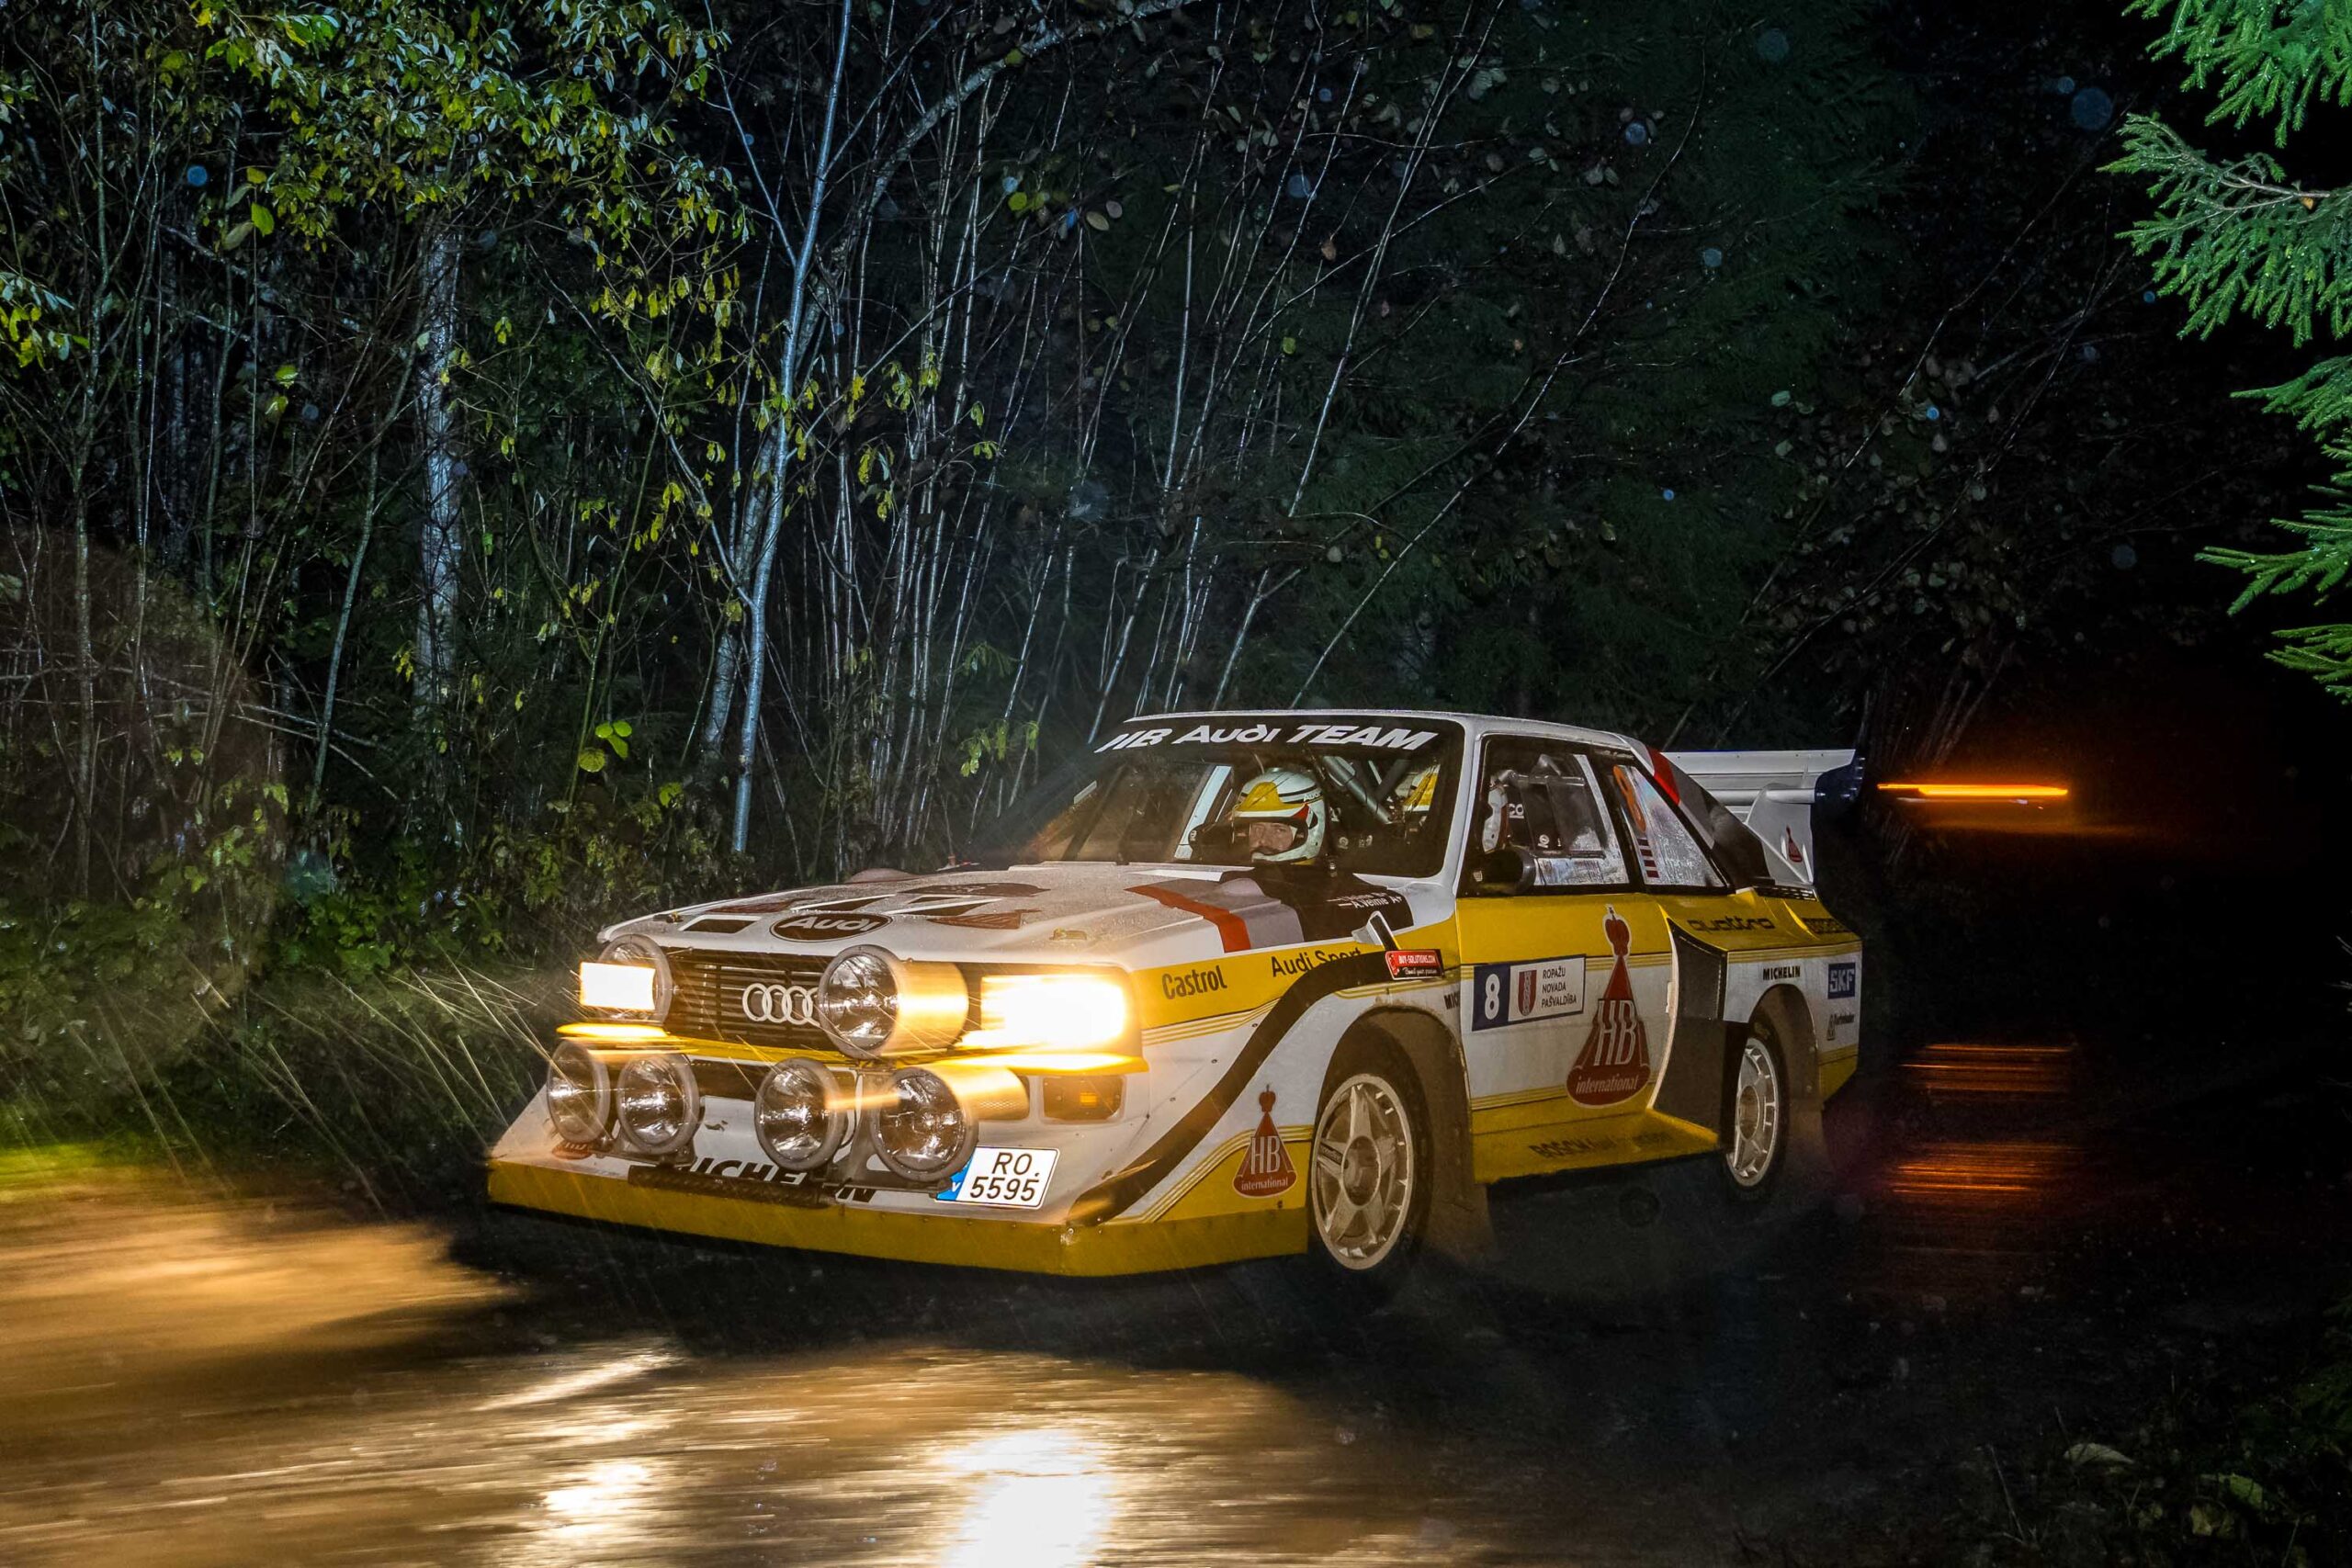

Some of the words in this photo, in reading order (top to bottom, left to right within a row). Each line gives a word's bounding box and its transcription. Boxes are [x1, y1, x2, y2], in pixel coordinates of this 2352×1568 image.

[1171, 724, 1283, 744] Audi
[1286, 724, 1439, 750] TEAM
[780, 916, 883, 932] Audi
[1272, 951, 1315, 977] Audi
[1543, 965, 1566, 979] ROPAŽU
[1763, 965, 1801, 981] MICHELIN
[1162, 964, 1228, 1000] Castrol
[1543, 982, 1566, 993] NOVADA
[1829, 969, 1855, 993] SKF
[1485, 974, 1500, 1020] 8
[1593, 999, 1638, 1066] HB
[1575, 1073, 1640, 1095] international
[1250, 1135, 1281, 1175] HB
[970, 1176, 1040, 1201] 5595
[1240, 1177, 1289, 1191] international
